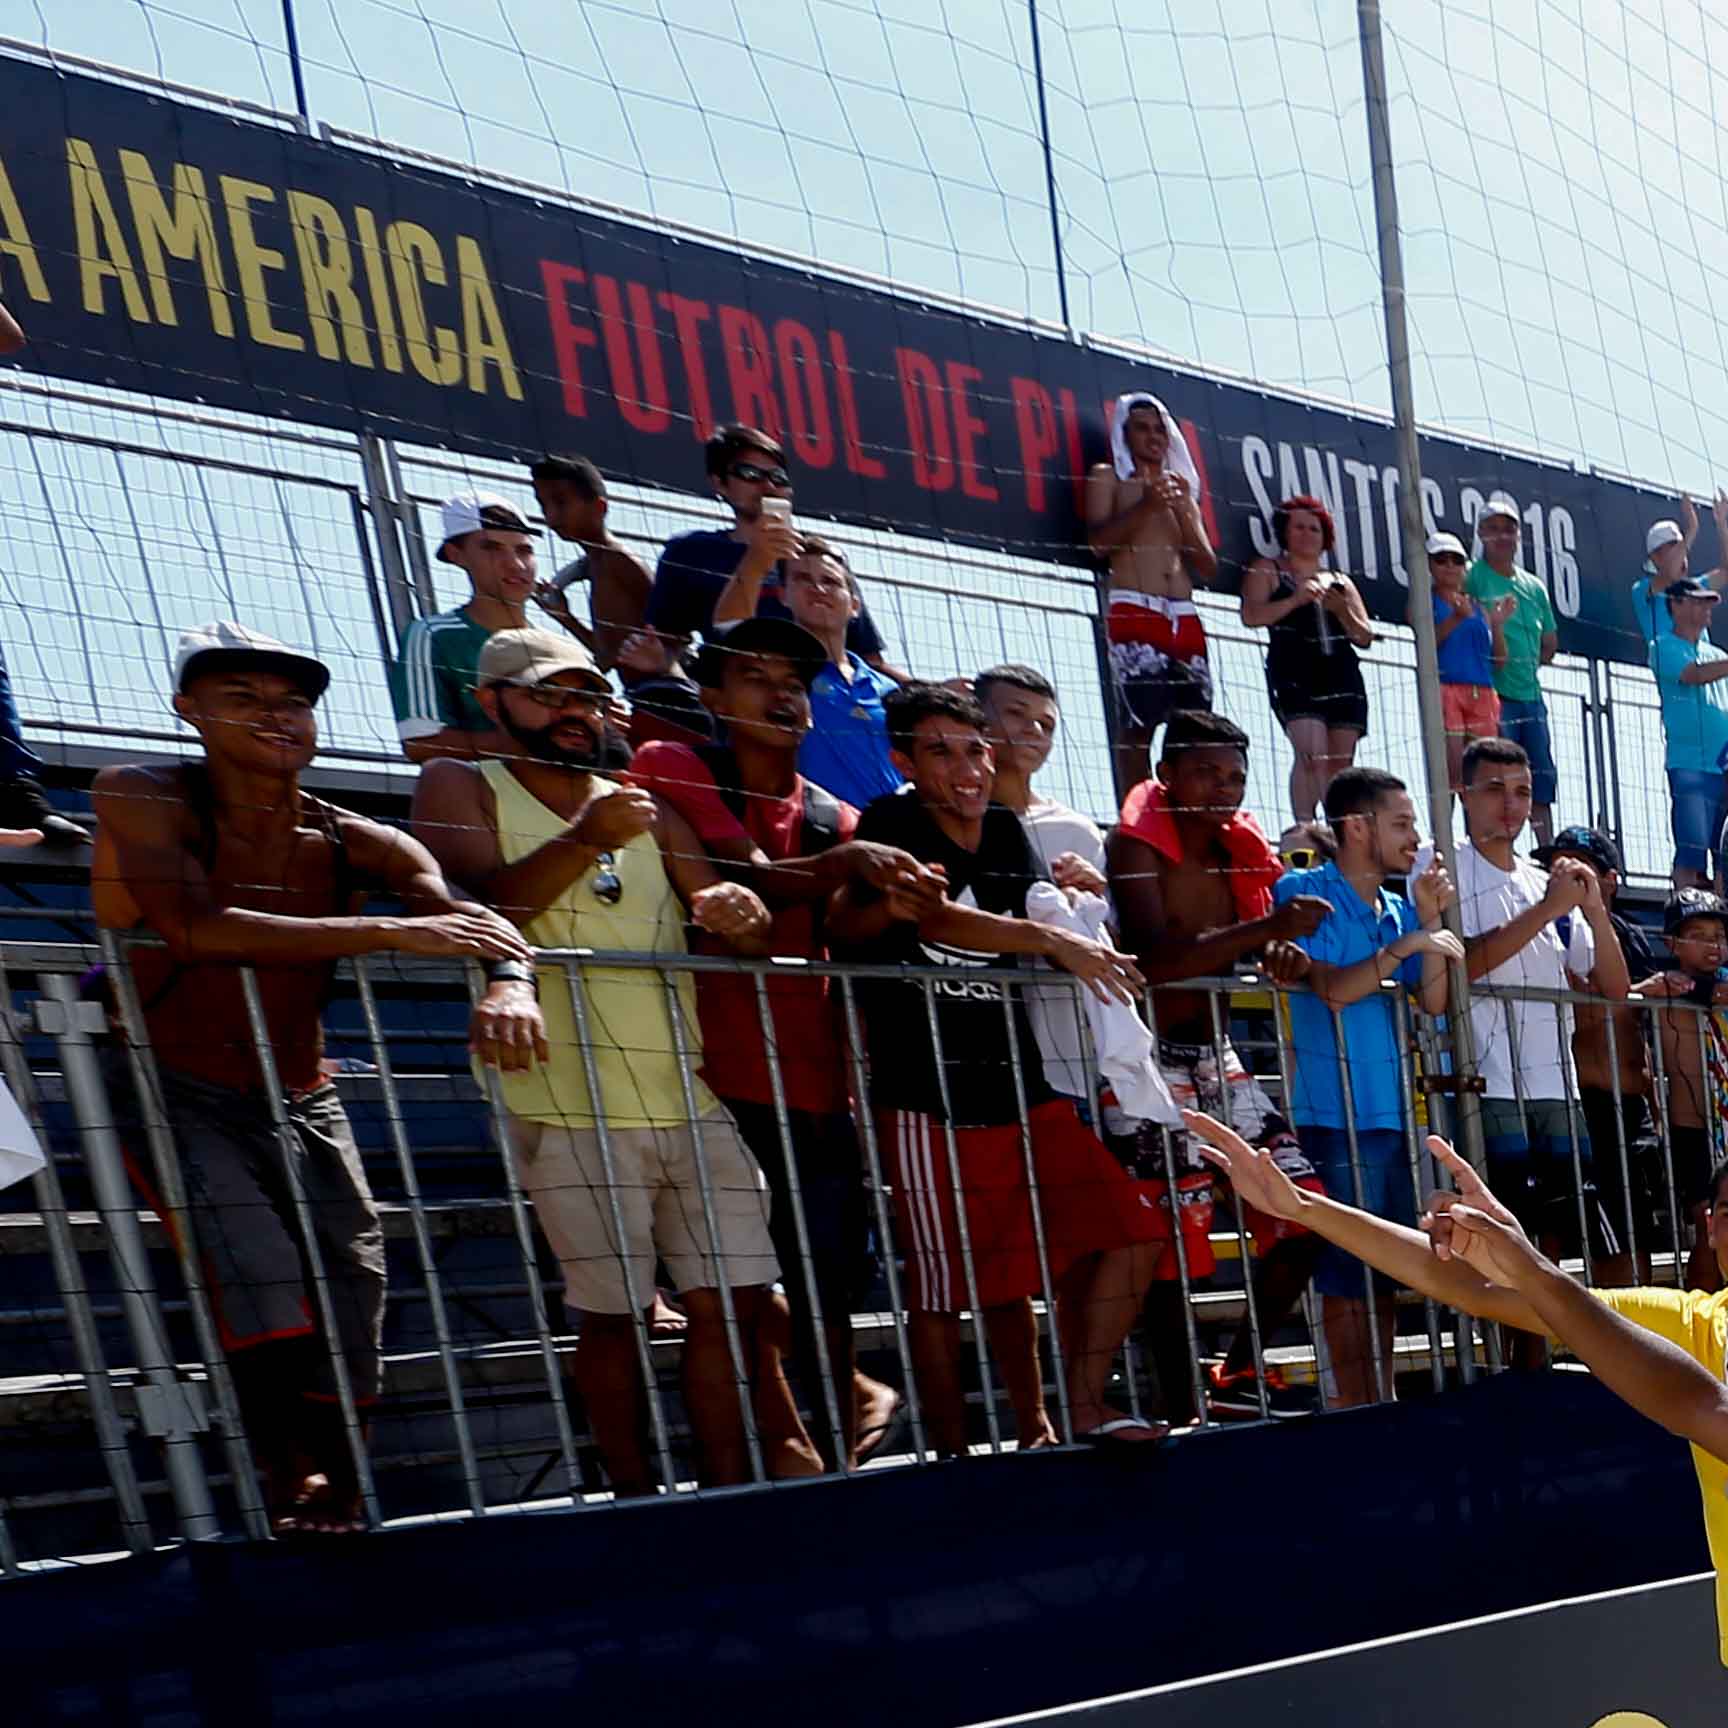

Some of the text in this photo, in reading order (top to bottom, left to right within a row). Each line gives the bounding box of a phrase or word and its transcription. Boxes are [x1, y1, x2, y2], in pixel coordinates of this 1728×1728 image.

[66, 136, 525, 401] AMERICA
[539, 259, 887, 480] FUTBOL
[895, 346, 999, 501] DE
